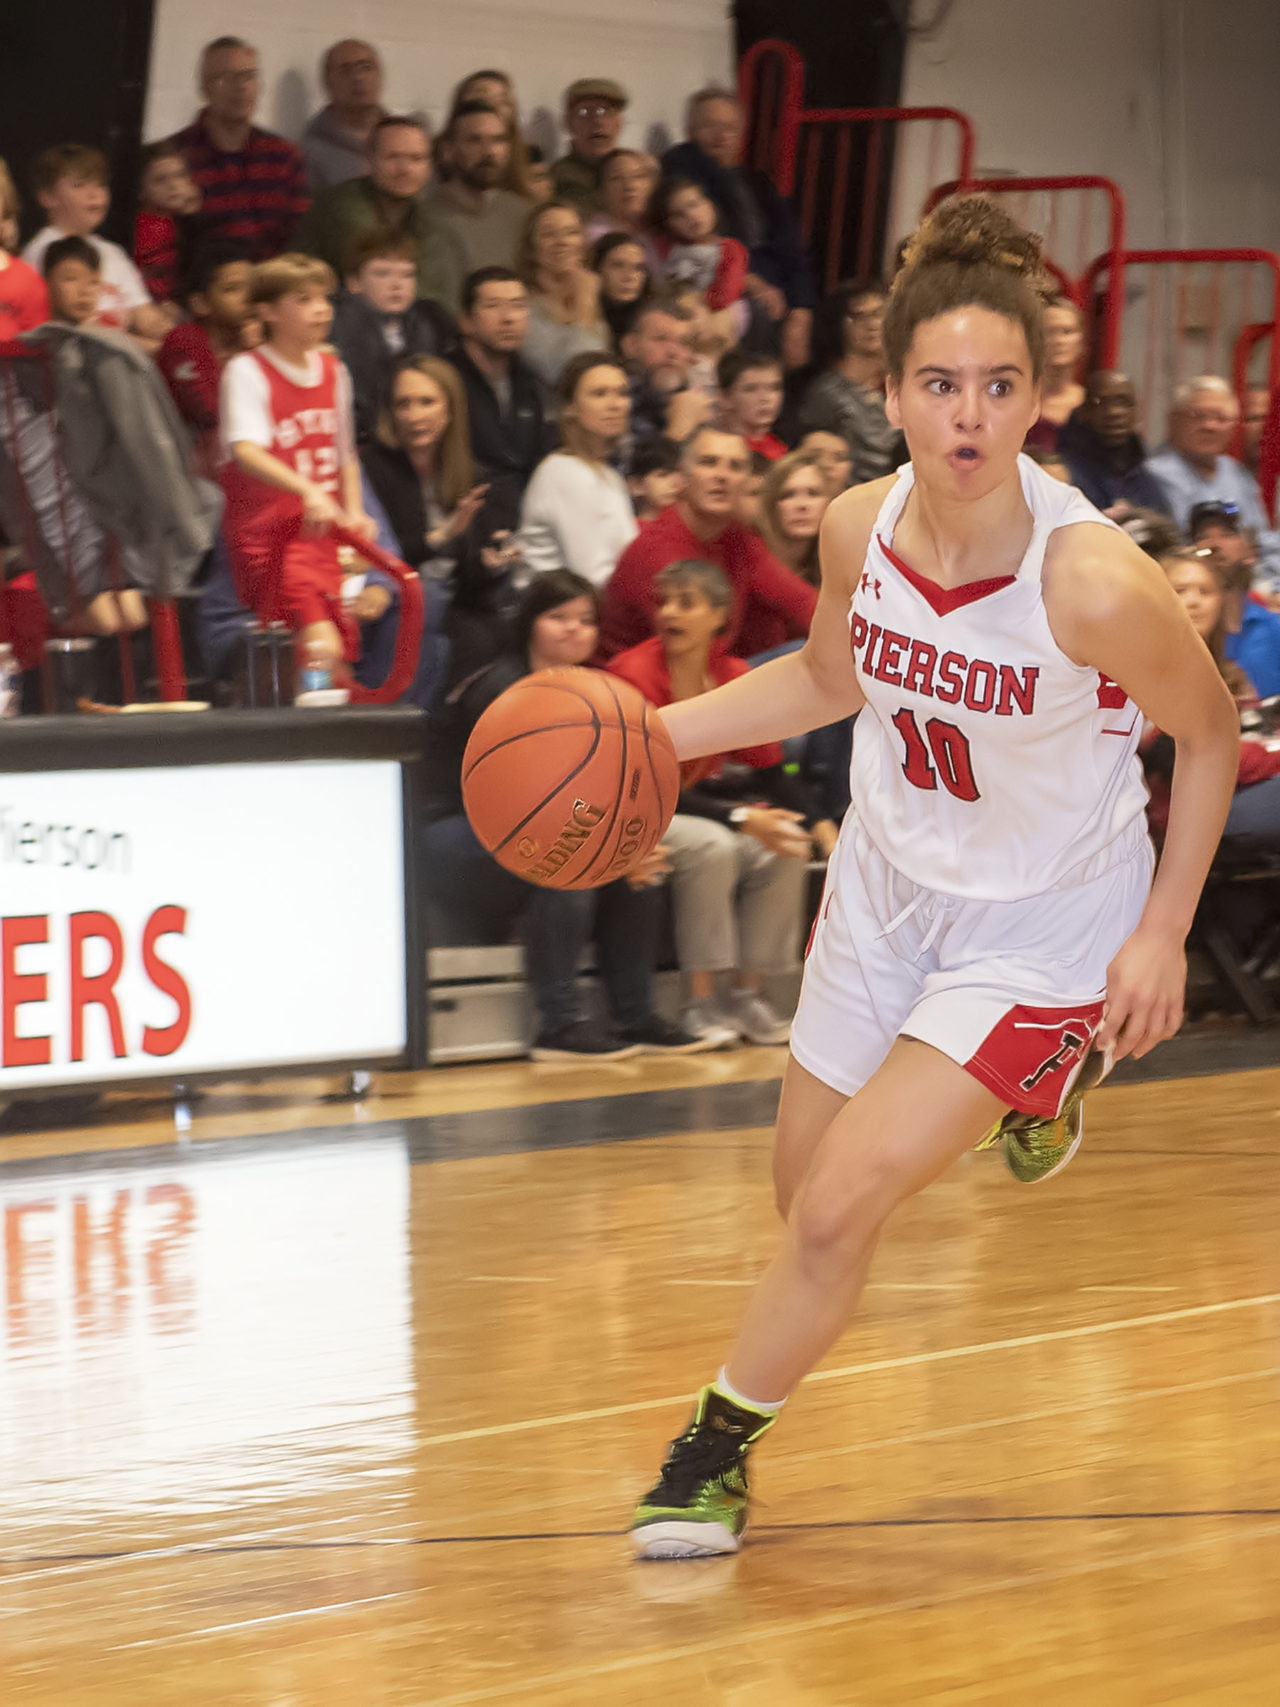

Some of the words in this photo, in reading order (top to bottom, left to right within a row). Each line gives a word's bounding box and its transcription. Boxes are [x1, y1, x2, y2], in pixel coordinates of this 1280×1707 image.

[851, 612, 1040, 716] PIERSON
[890, 707, 983, 803] 10
[0, 803, 133, 875] ierson
[0, 903, 193, 1068] ERS
